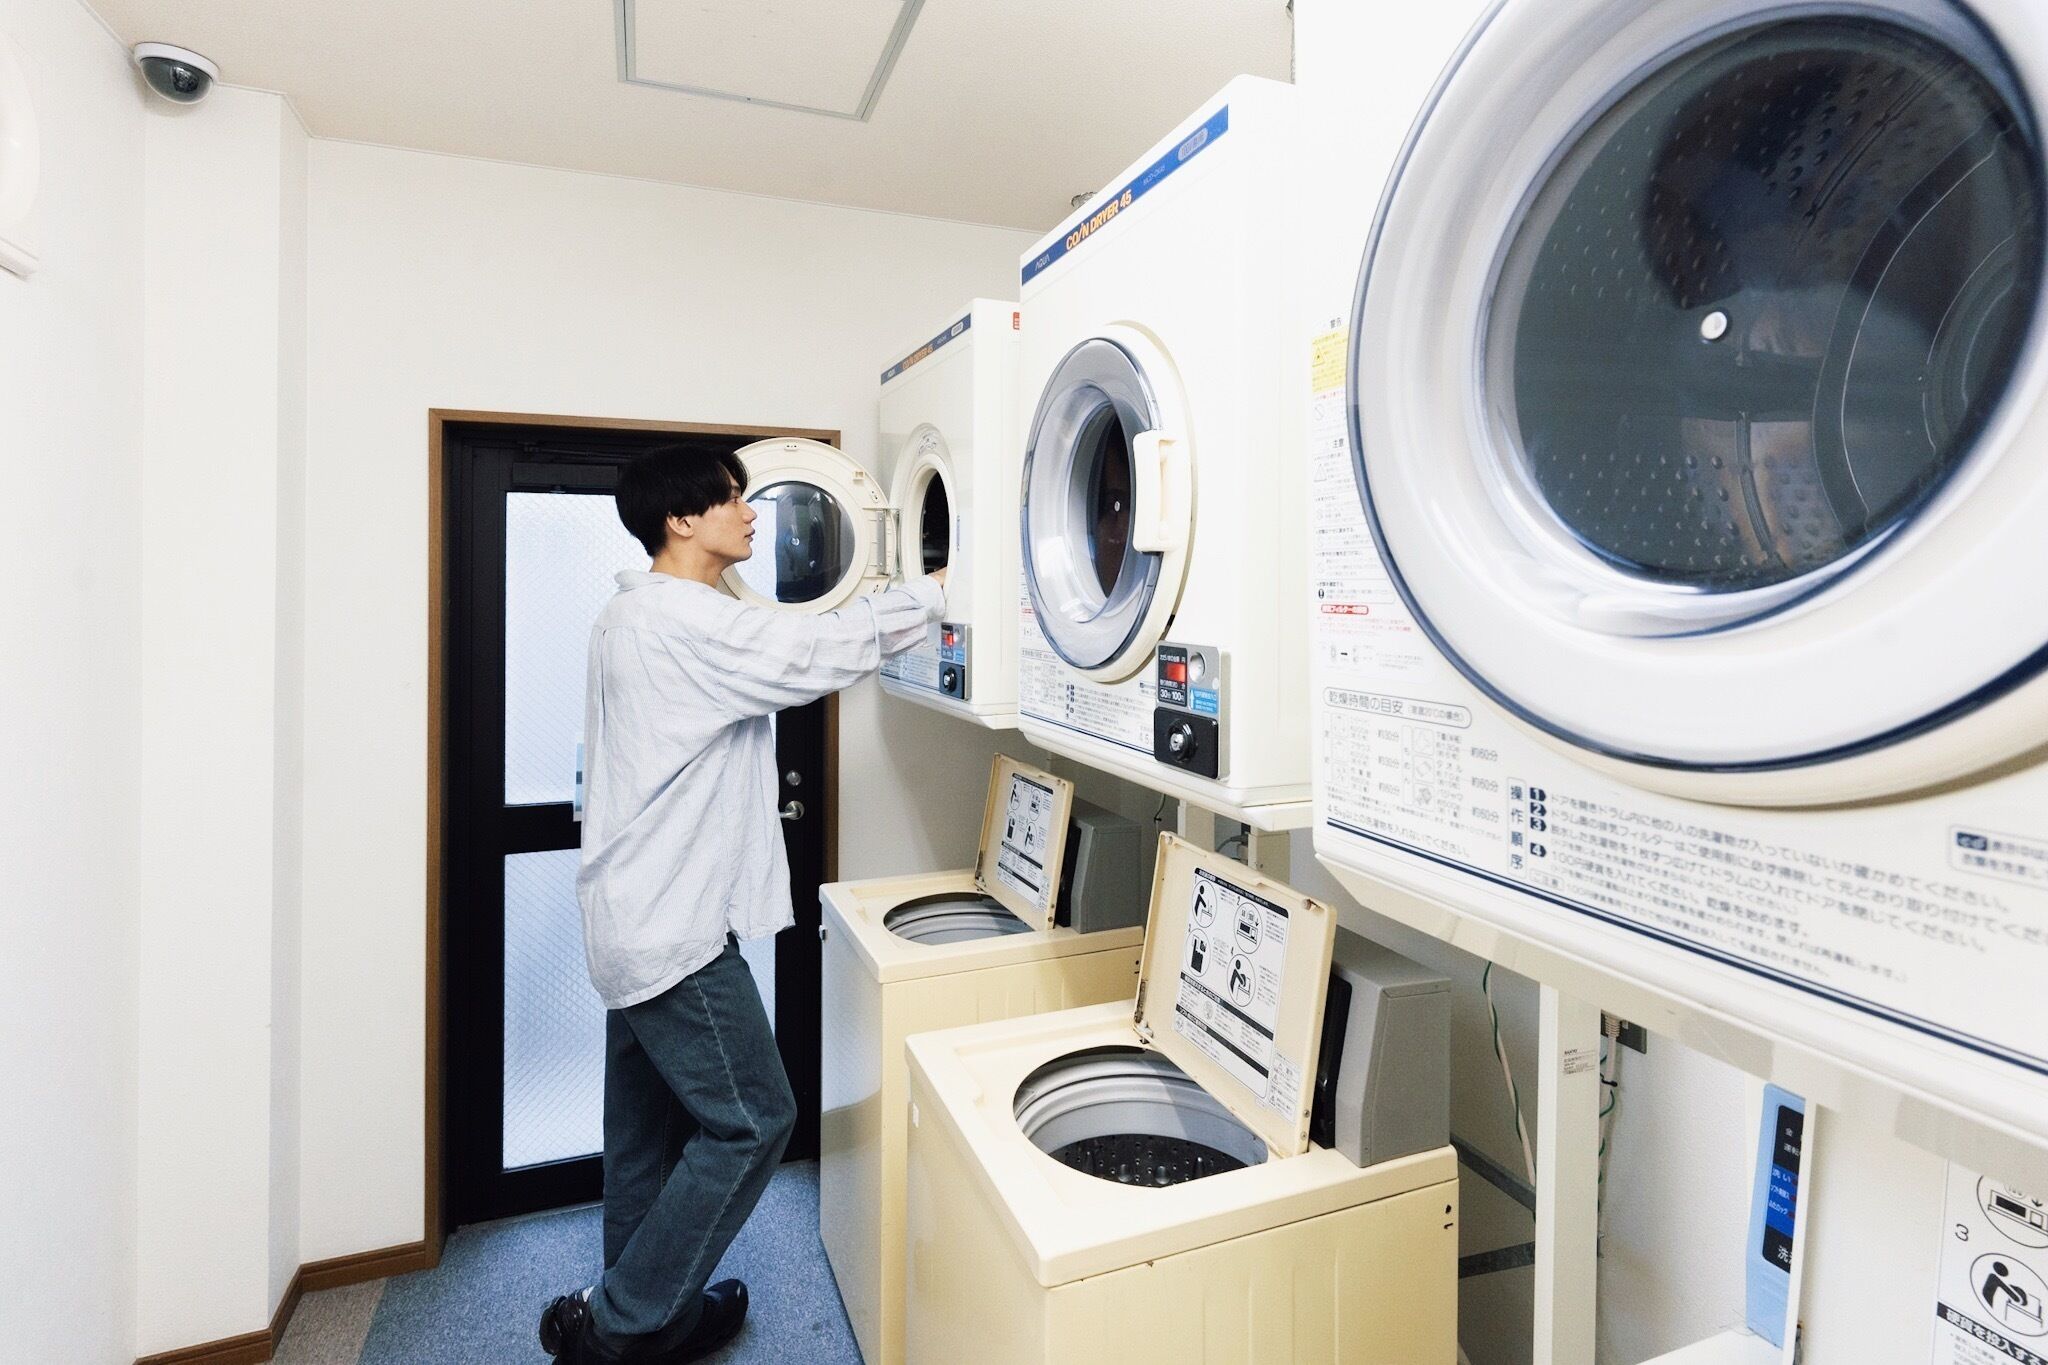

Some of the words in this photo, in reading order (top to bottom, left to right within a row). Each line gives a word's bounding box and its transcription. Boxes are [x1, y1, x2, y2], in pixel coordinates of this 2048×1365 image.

[1090, 199, 1119, 233] DRYER
[1120, 189, 1132, 209] 45
[1328, 690, 1403, 715] 乾燥時間の目安
[1510, 784, 1524, 871] 操作順序
[1783, 1142, 1802, 1157] 運転
[1955, 1223, 1969, 1242] 3
